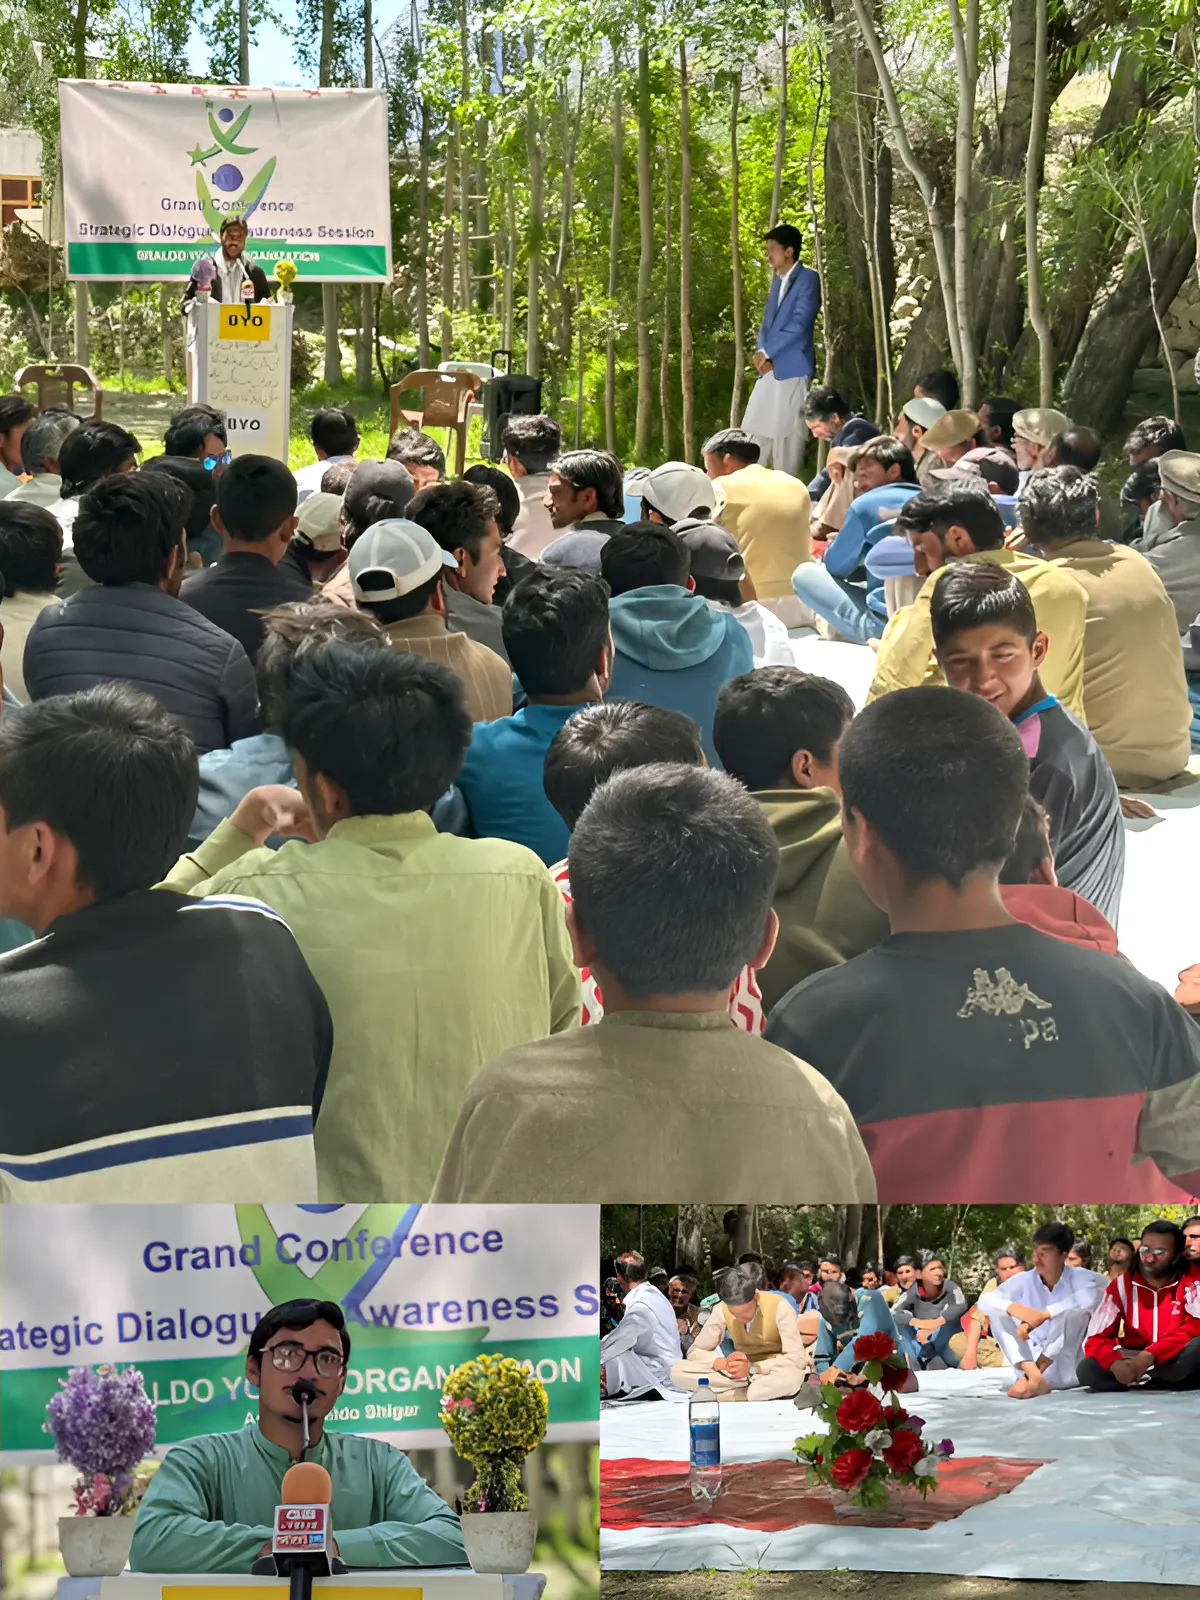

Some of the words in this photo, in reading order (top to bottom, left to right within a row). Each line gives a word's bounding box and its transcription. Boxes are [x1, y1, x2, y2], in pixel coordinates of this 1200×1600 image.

[228, 315, 263, 327] BYO
[143, 1235, 261, 1273] Grand
[276, 1229, 504, 1265] Conference
[116, 1308, 262, 1345] Dialogu
[152, 1378, 214, 1406] LDO
